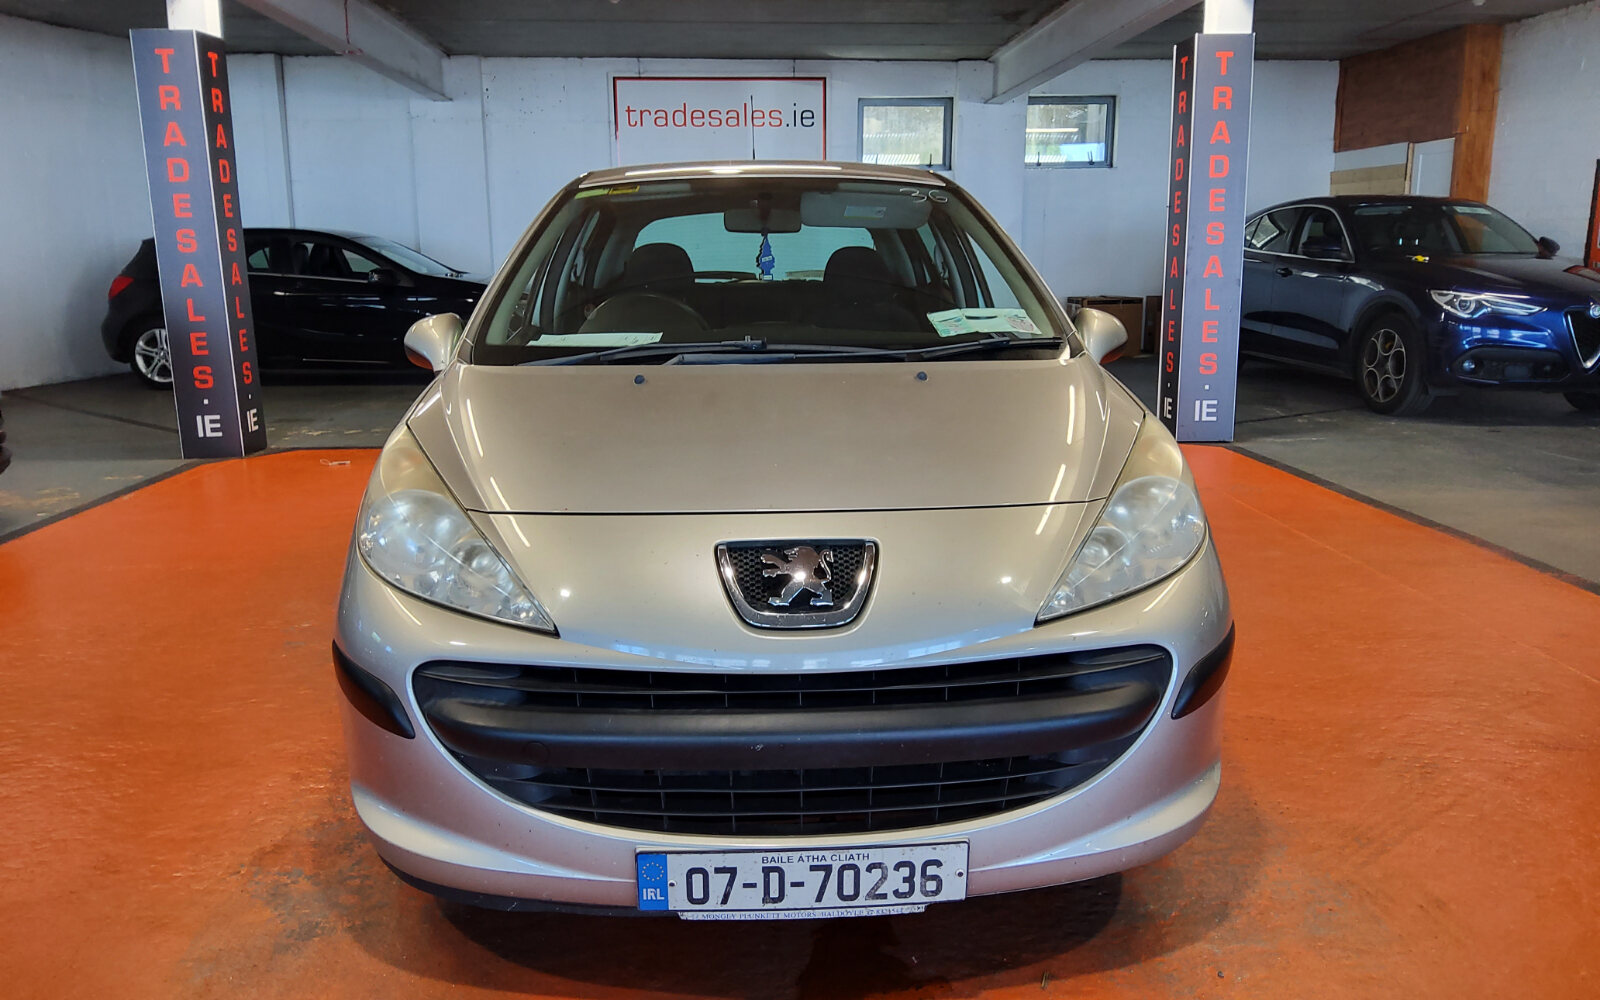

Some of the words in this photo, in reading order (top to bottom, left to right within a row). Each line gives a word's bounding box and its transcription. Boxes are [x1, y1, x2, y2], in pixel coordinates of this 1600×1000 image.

[625, 102, 815, 128] tradesales.ie
[830, 853, 870, 862] CLIATH
[685, 859, 944, 907] 07-D-70236
[642, 888, 665, 901] IRL
[783, 911, 817, 919] MOTORS
